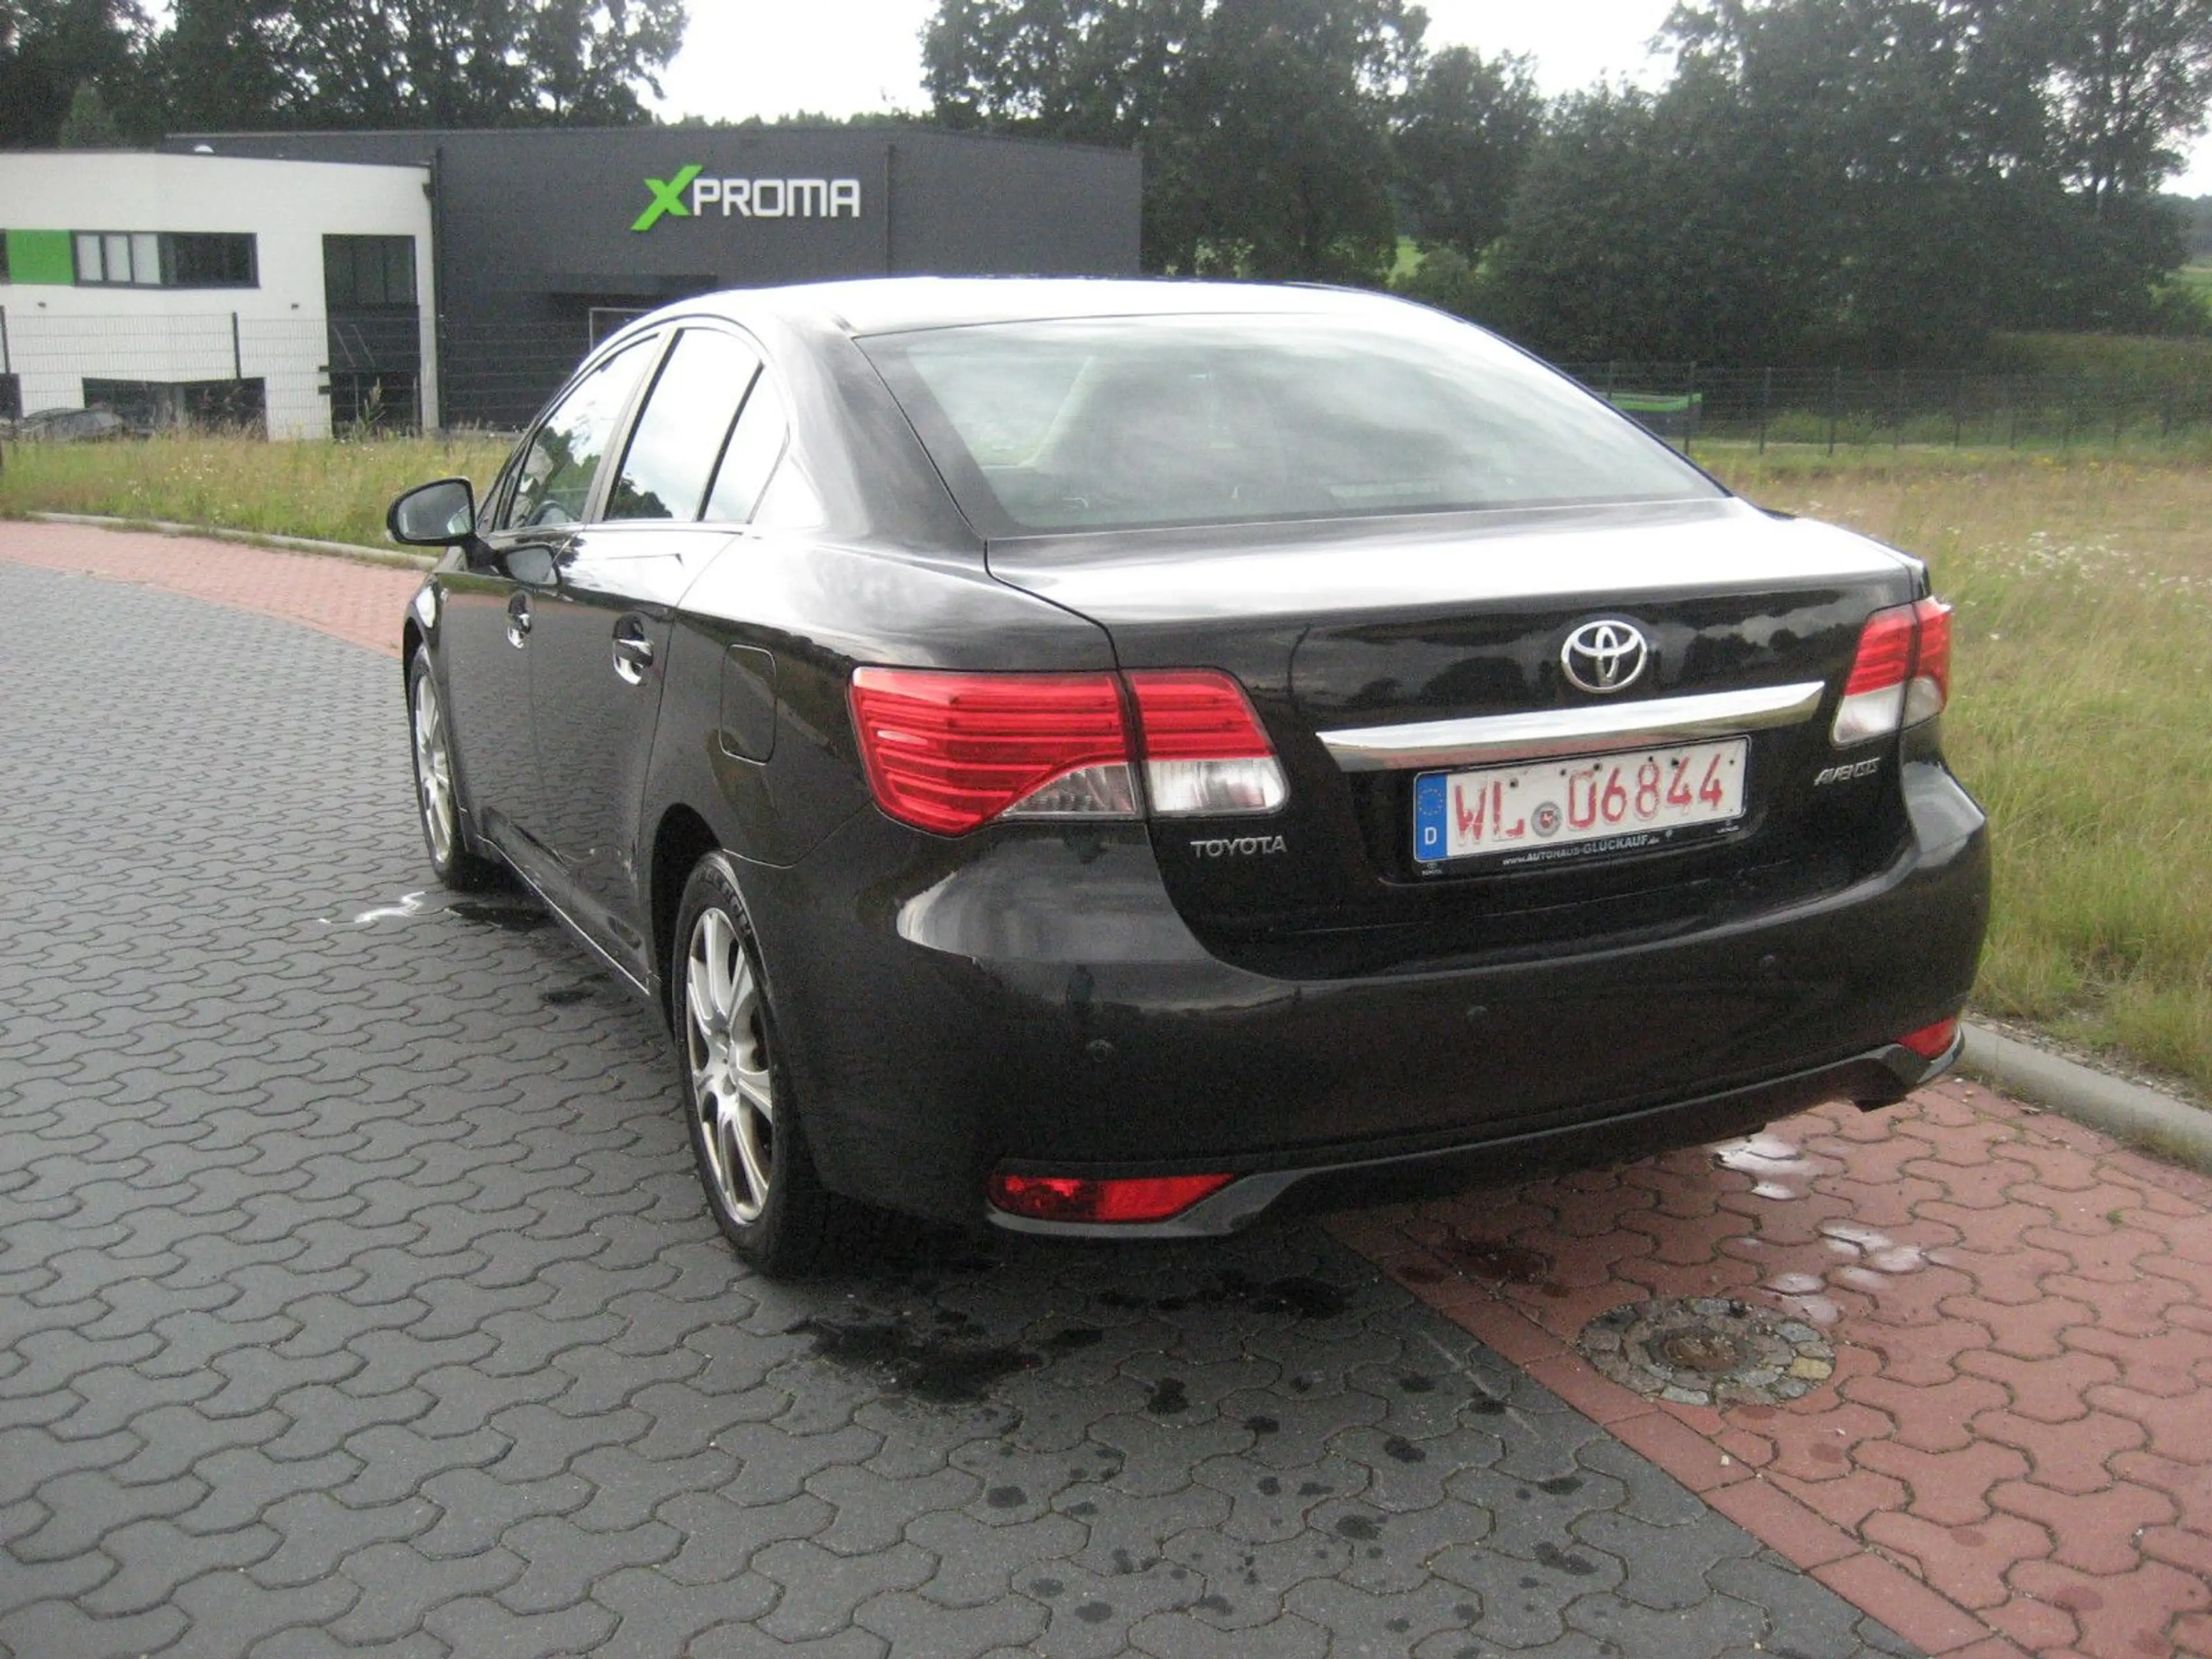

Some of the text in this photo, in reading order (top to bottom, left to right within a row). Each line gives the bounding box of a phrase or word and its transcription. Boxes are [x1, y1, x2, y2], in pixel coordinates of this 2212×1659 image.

[631, 164, 861, 231] XPROMA
[1455, 780, 1526, 845] WL
[1190, 835, 1288, 858] TOYOTA
[1425, 827, 1437, 845] D
